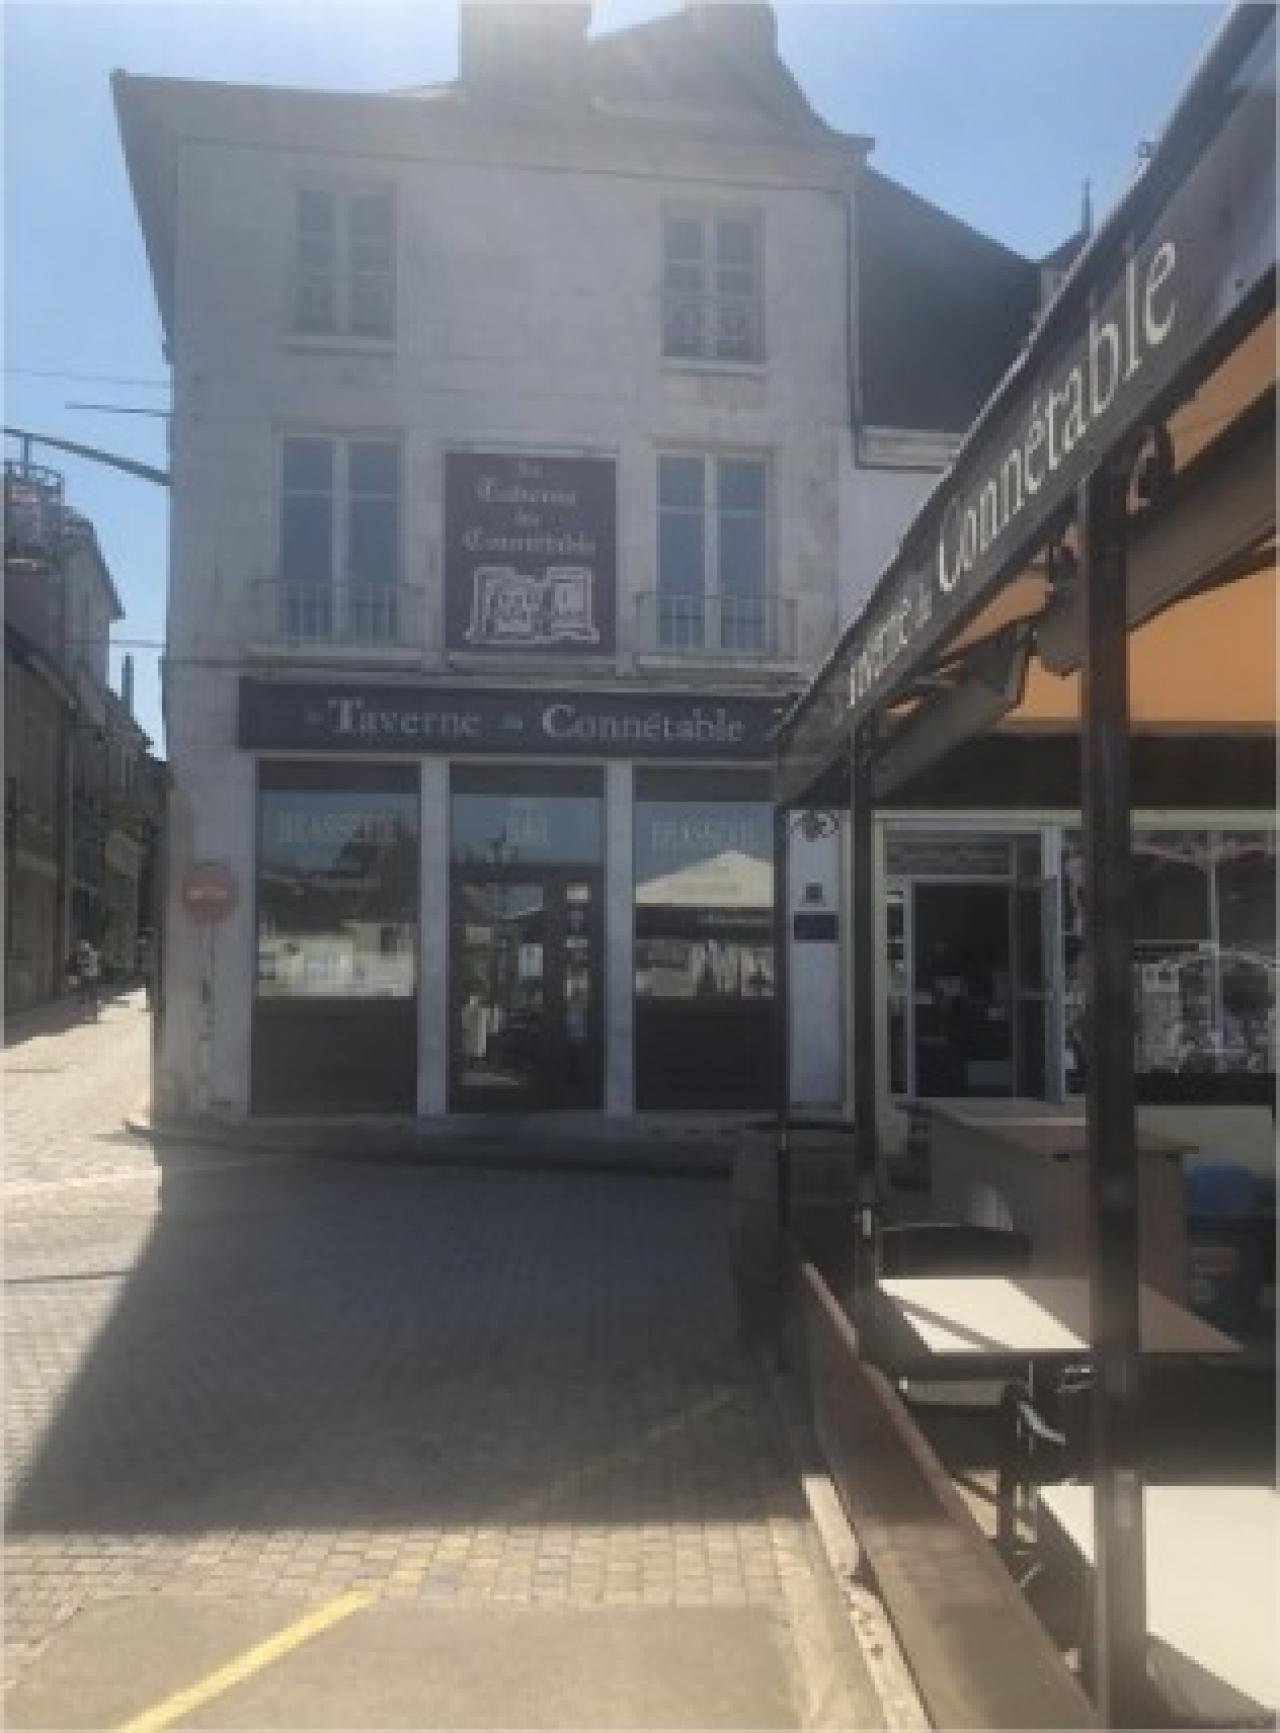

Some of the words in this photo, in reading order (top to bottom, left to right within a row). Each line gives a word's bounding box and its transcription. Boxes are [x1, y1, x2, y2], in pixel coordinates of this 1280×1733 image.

[937, 241, 1177, 593] Connétable
[327, 697, 481, 739] Taverne
[540, 703, 744, 742] Connétable
